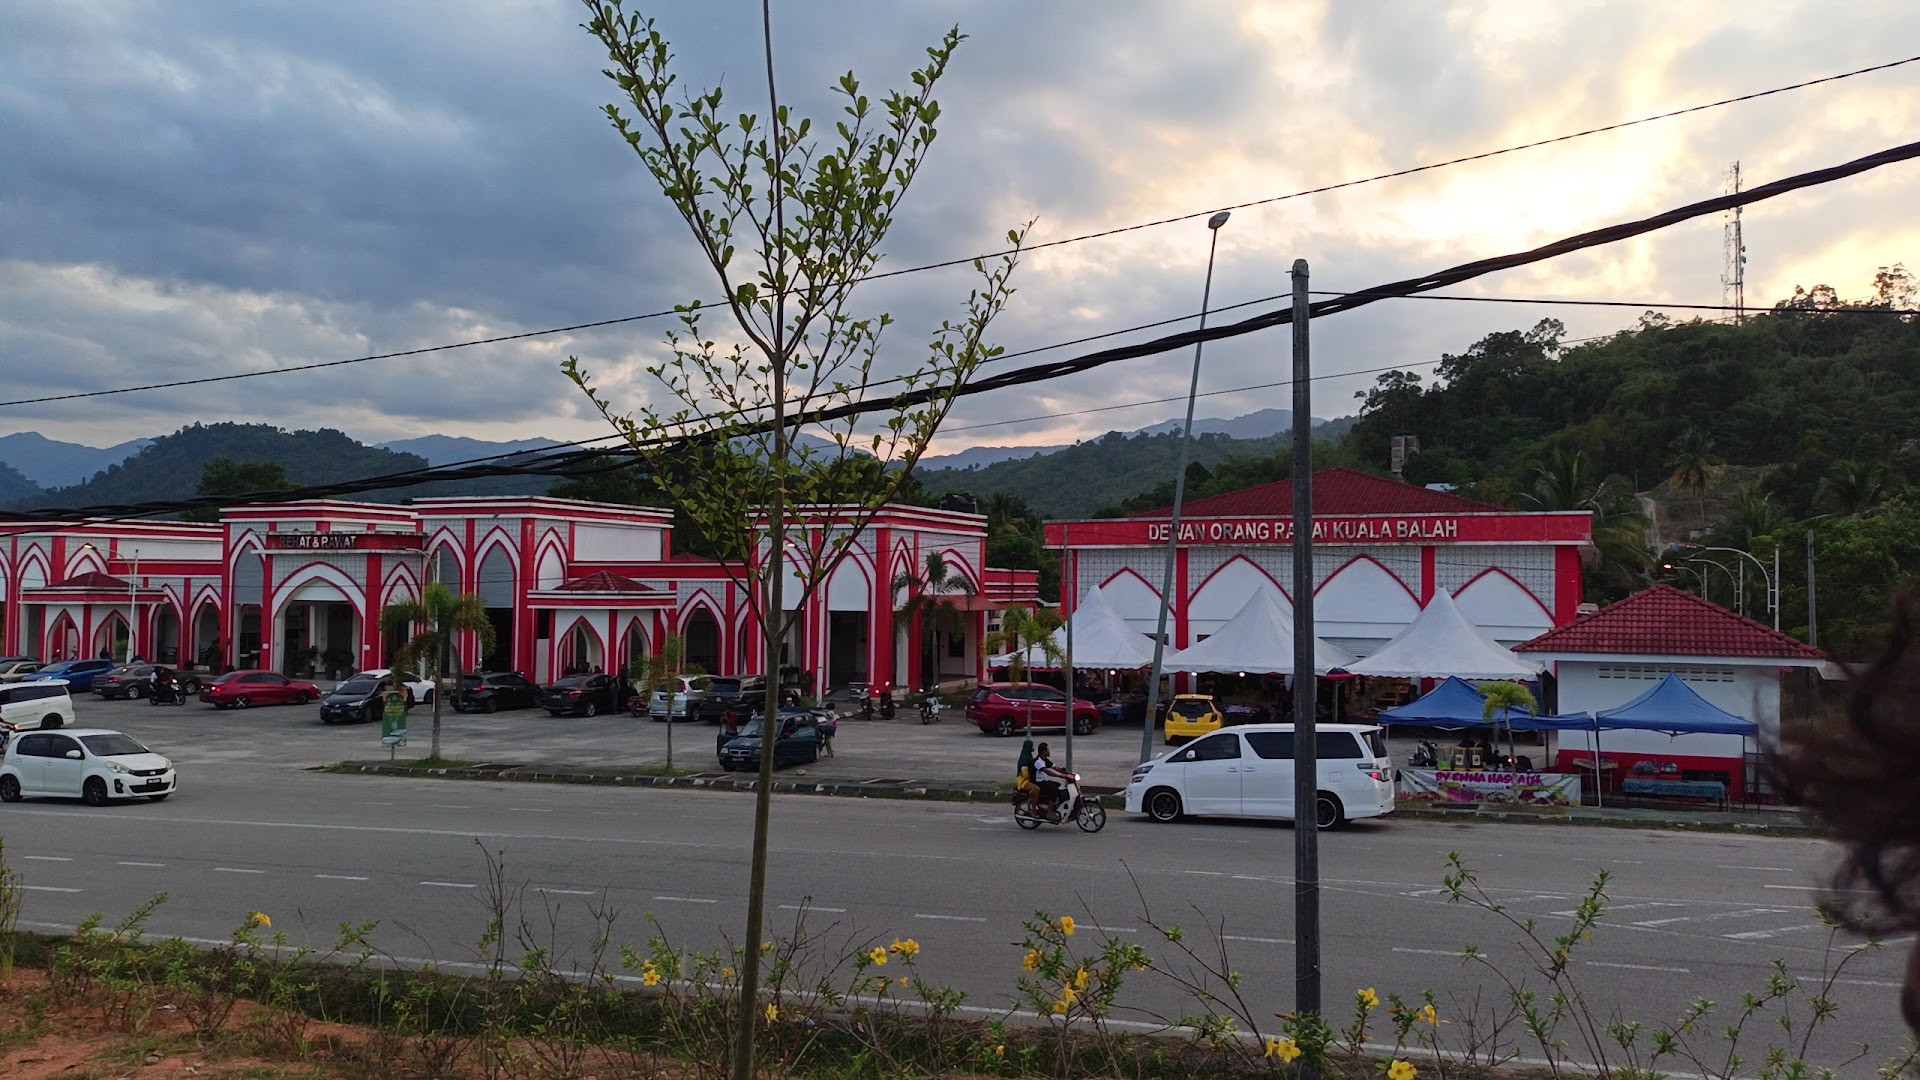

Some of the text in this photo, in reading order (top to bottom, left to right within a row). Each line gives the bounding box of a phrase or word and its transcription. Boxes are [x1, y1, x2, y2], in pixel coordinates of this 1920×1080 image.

[1149, 519, 1457, 541] DEWAN ORANG RAAI KUALA BALAH
[280, 535, 356, 548] REHAT & RAWAT
[1452, 772, 1485, 782] EMMA
